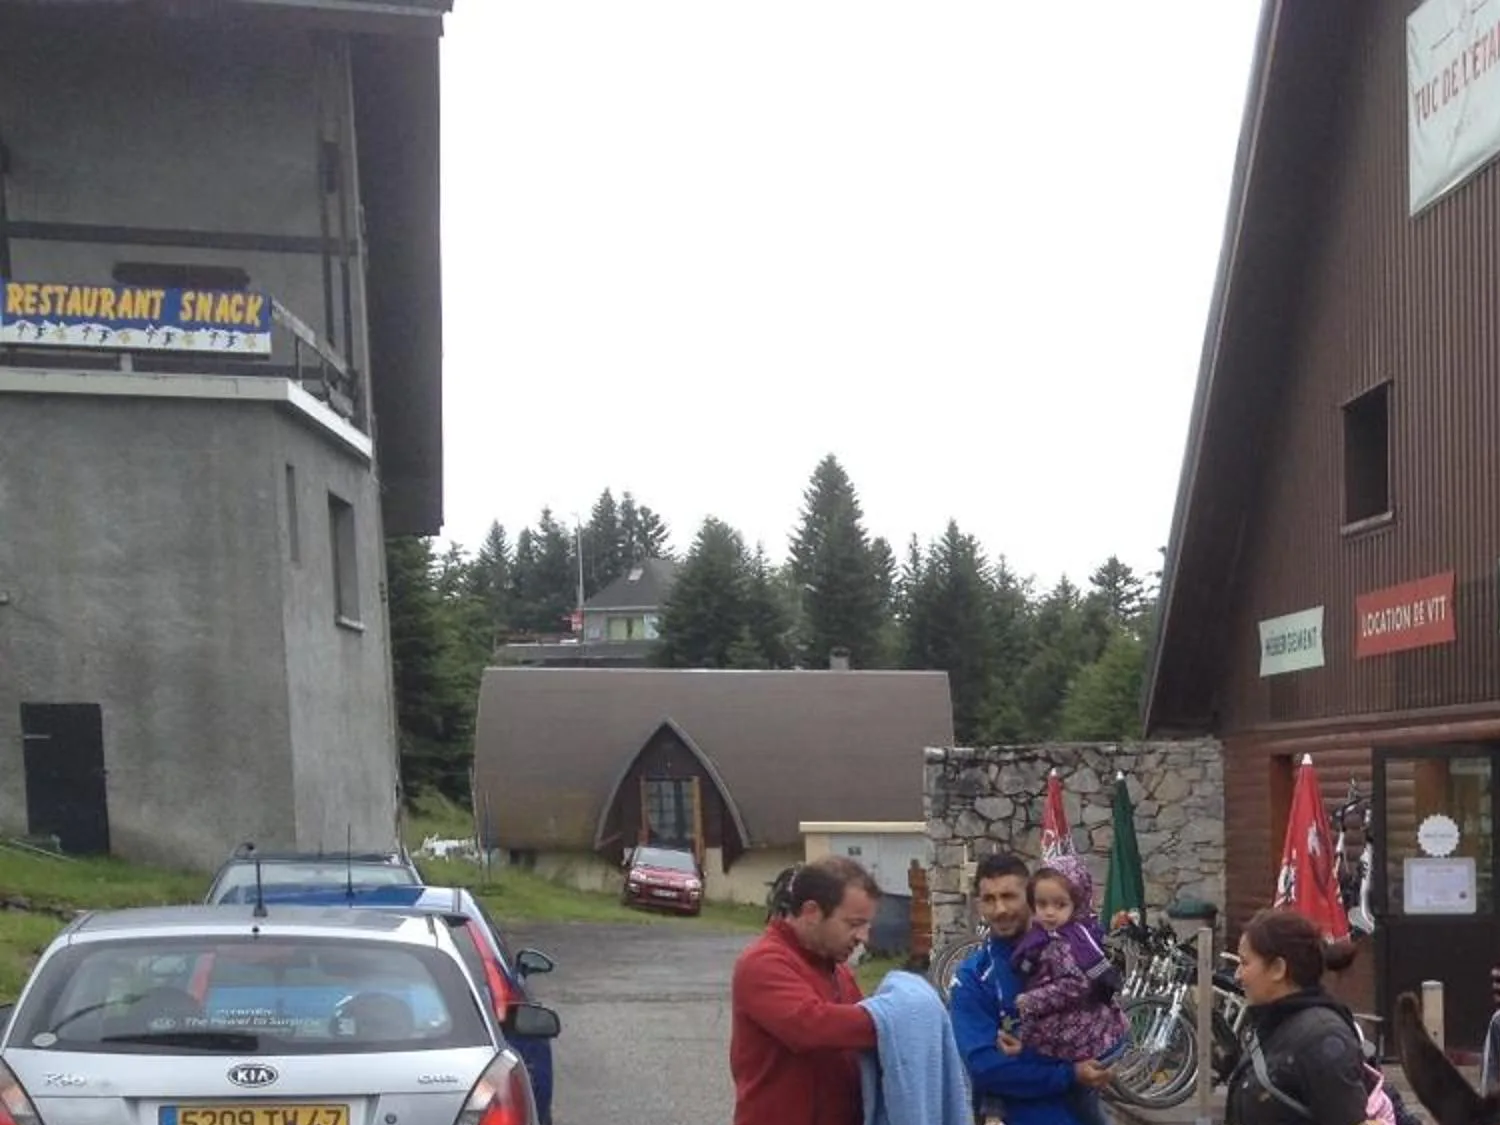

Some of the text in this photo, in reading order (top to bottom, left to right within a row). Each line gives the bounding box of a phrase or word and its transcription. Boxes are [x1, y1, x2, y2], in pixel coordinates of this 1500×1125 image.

[1413, 76, 1439, 128] TUC
[1442, 58, 1459, 106] DE
[6, 282, 263, 327] RESTAURANT SNACK
[1361, 595, 1447, 638] LOCATION DE VTT
[237, 1067, 268, 1083] KIA
